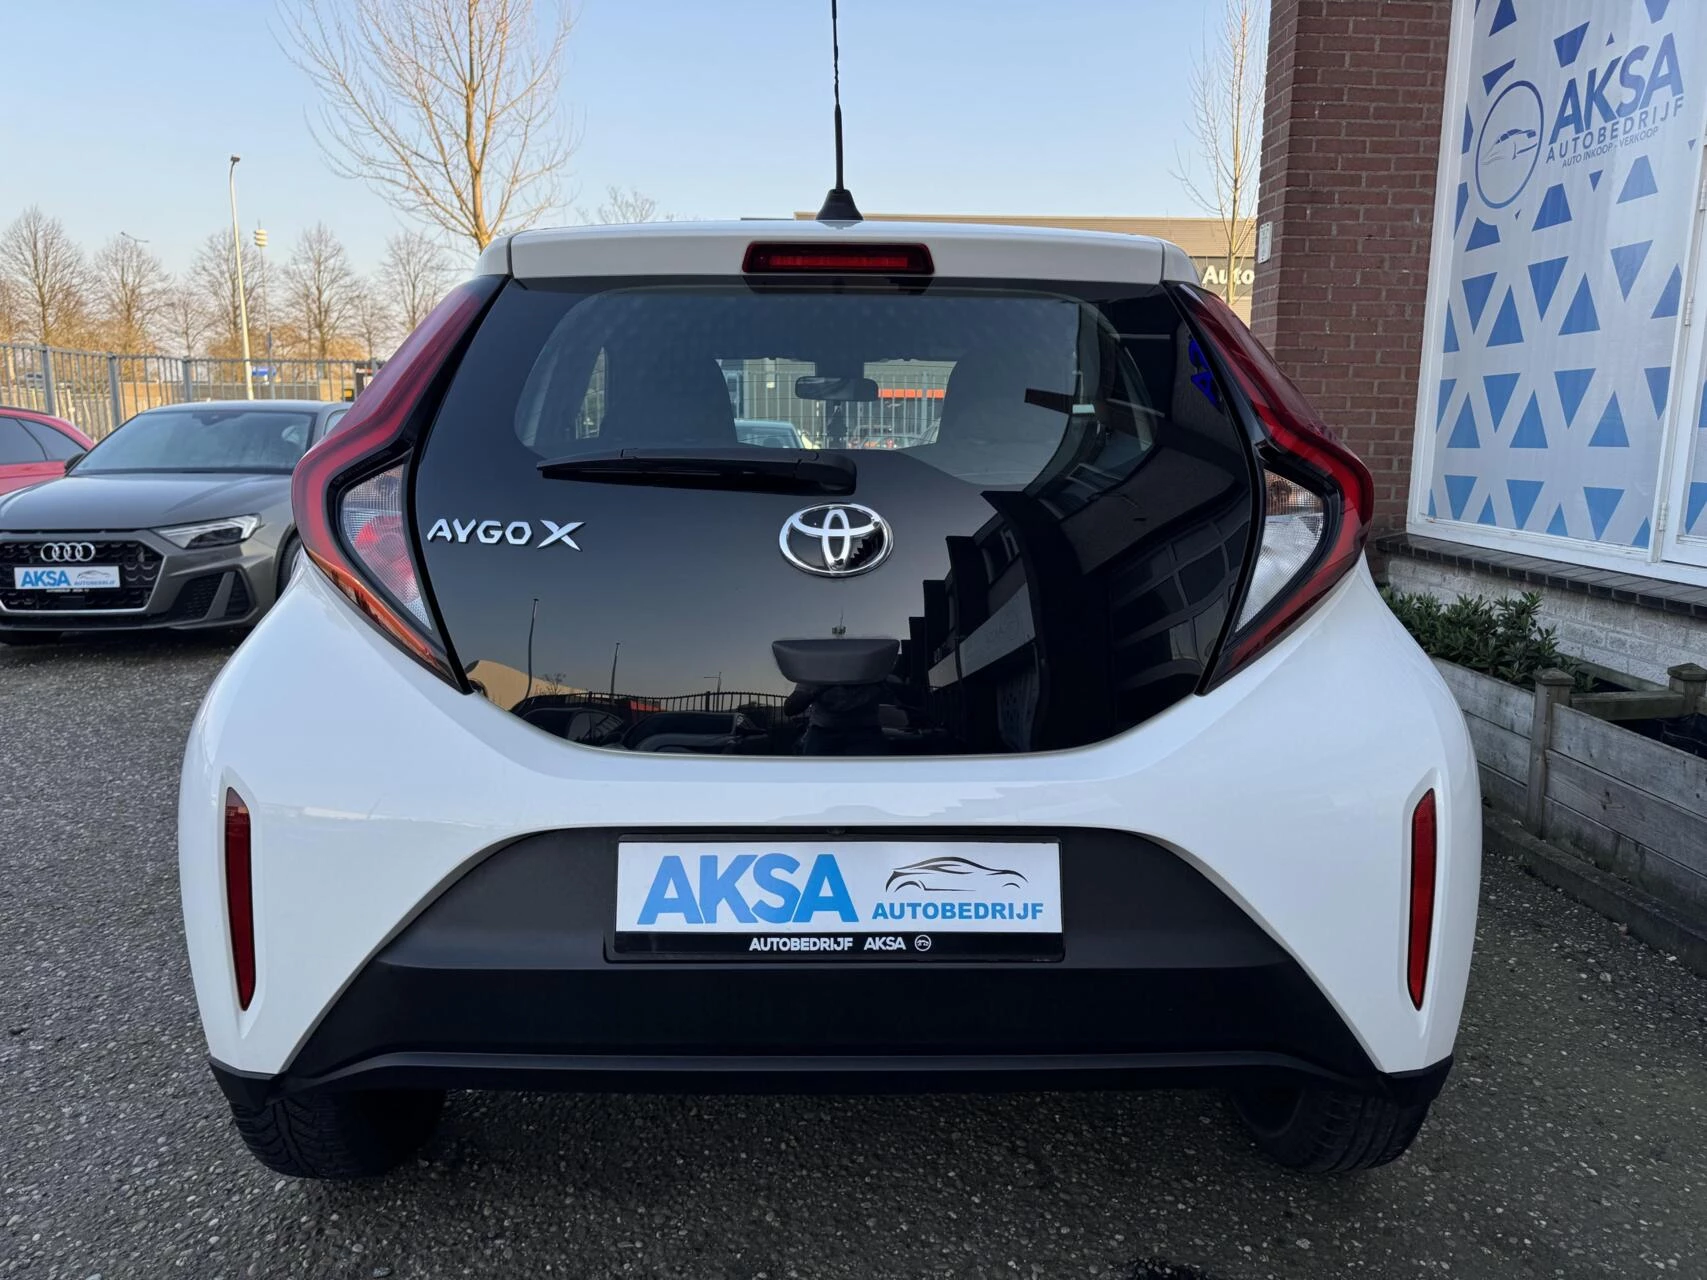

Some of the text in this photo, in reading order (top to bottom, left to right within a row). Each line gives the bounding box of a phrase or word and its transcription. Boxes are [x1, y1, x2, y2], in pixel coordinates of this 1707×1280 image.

[1548, 32, 1684, 145] AKSA
[1546, 96, 1684, 163] AUTOBEDRIJF
[1562, 154, 1582, 168] AUTO
[1583, 143, 1614, 162] INKOOP
[1619, 126, 1659, 148] VERKOOP
[1202, 264, 1255, 285] Auto
[426, 518, 585, 552] AYGO X
[21, 570, 70, 587] AKSA
[637, 853, 859, 924] AKSA
[871, 902, 1044, 920] AUTOBEDRIJF
[749, 937, 907, 952] AUTOBEDRIJF AKSA
